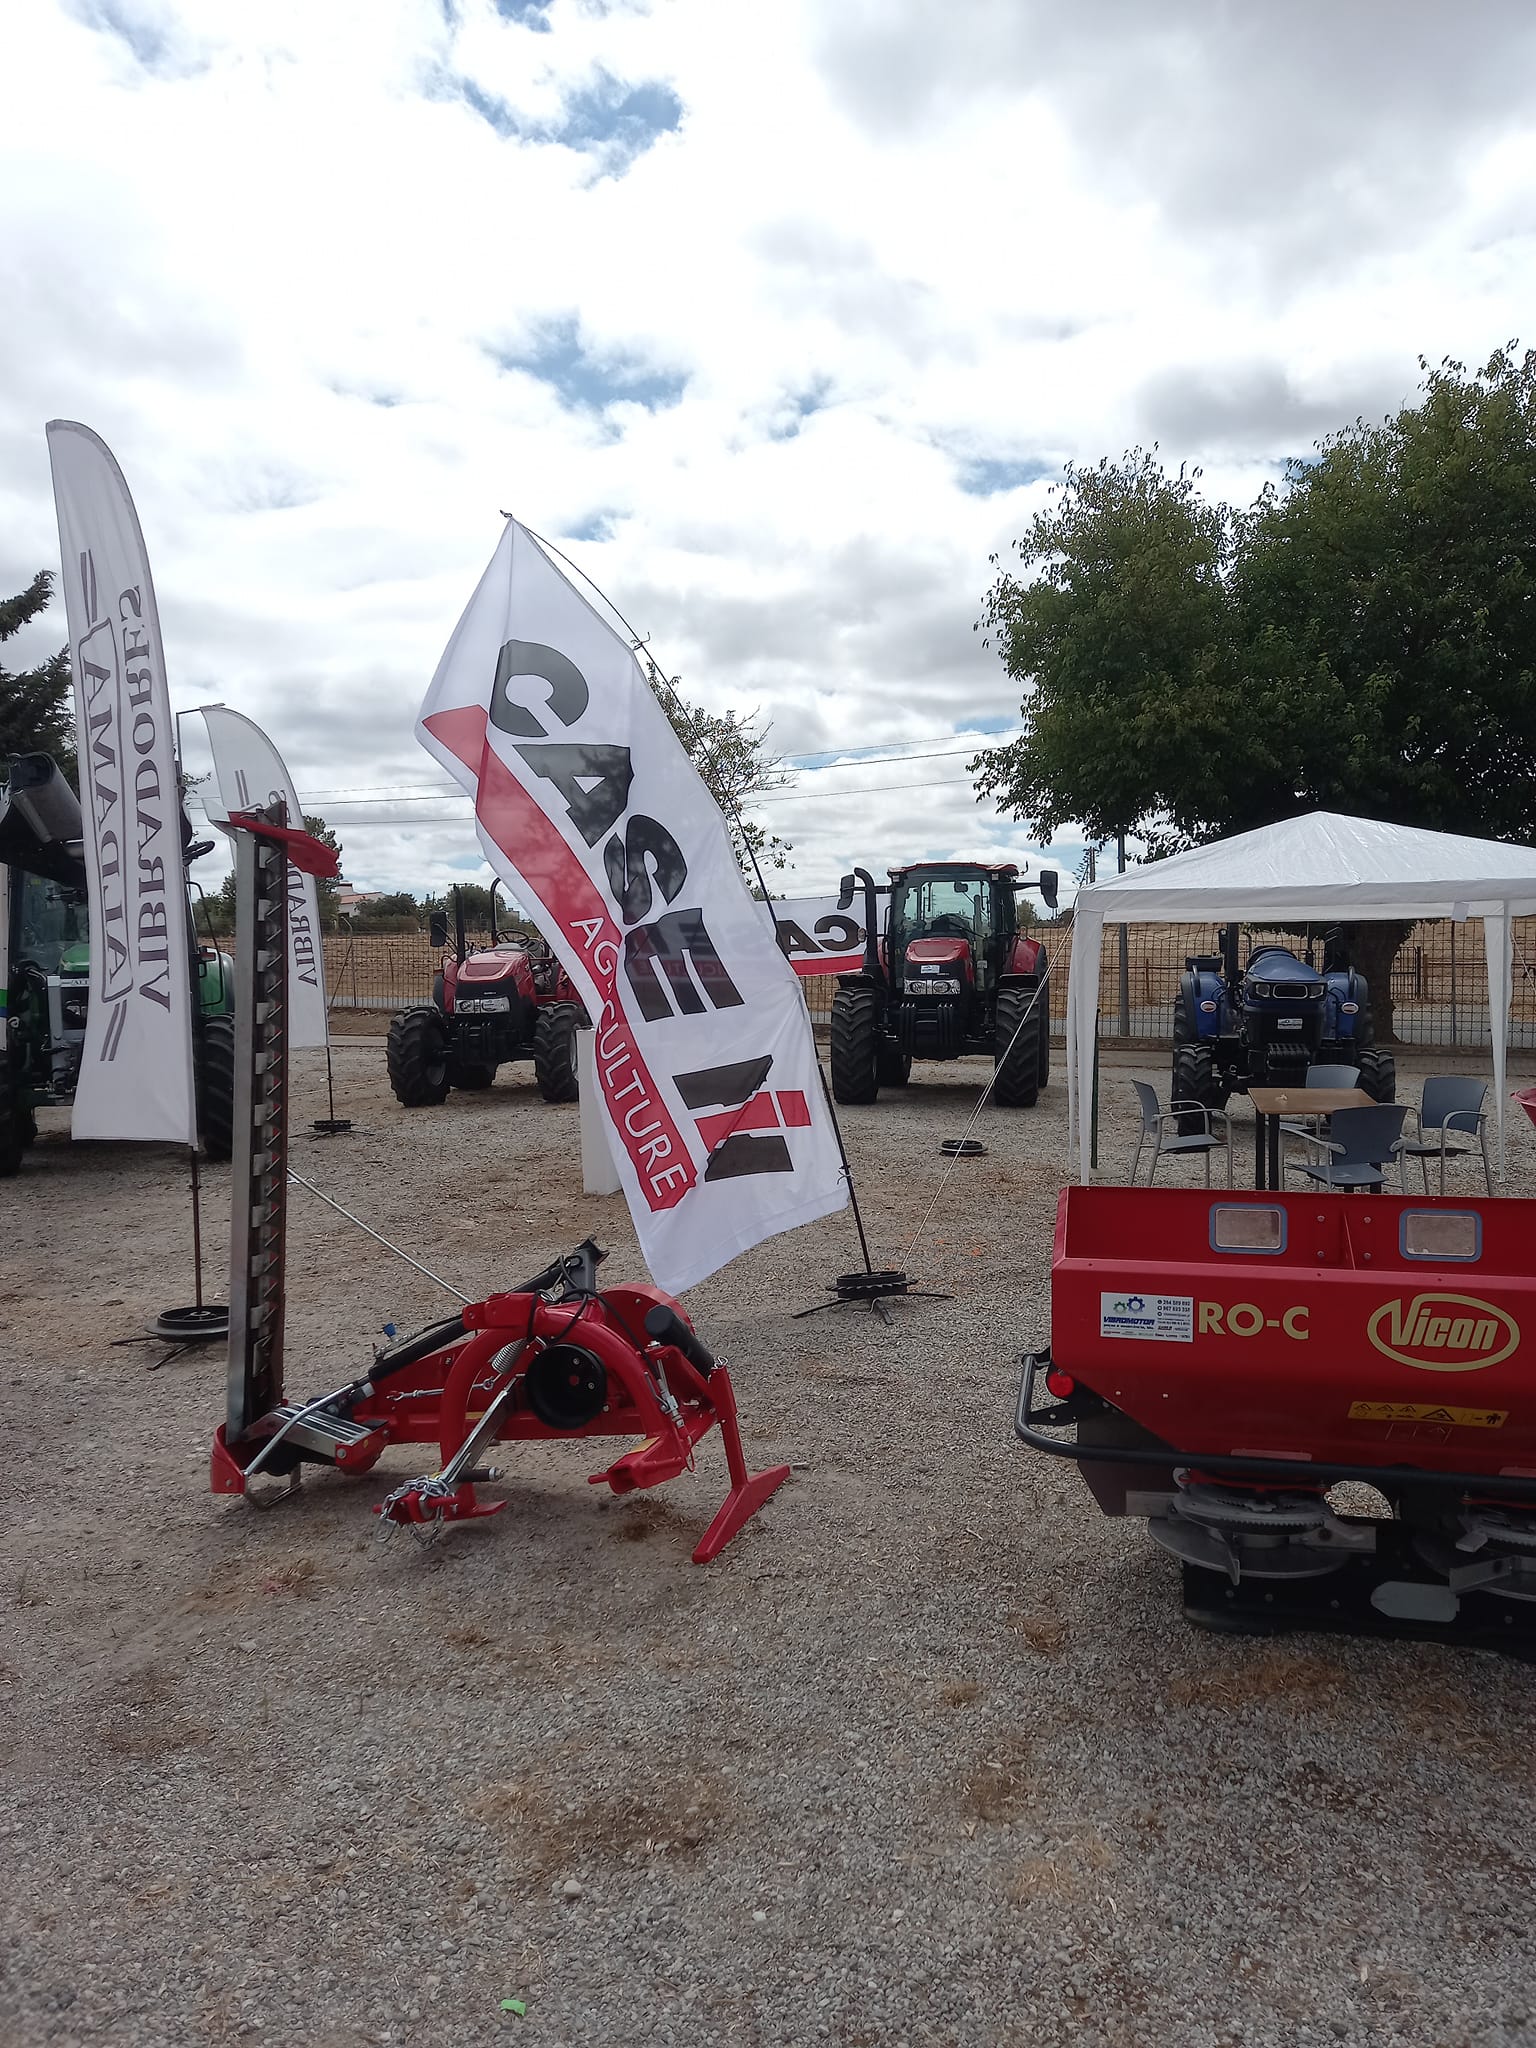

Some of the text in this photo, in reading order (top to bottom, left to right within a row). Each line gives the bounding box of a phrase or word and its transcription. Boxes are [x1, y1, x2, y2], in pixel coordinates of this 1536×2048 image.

[489, 638, 744, 1023] CASE
[1103, 1316, 1155, 1325] VIBROMOTOR
[1198, 1302, 1309, 1340] RO-C
[1391, 1298, 1499, 1350] Vicon
